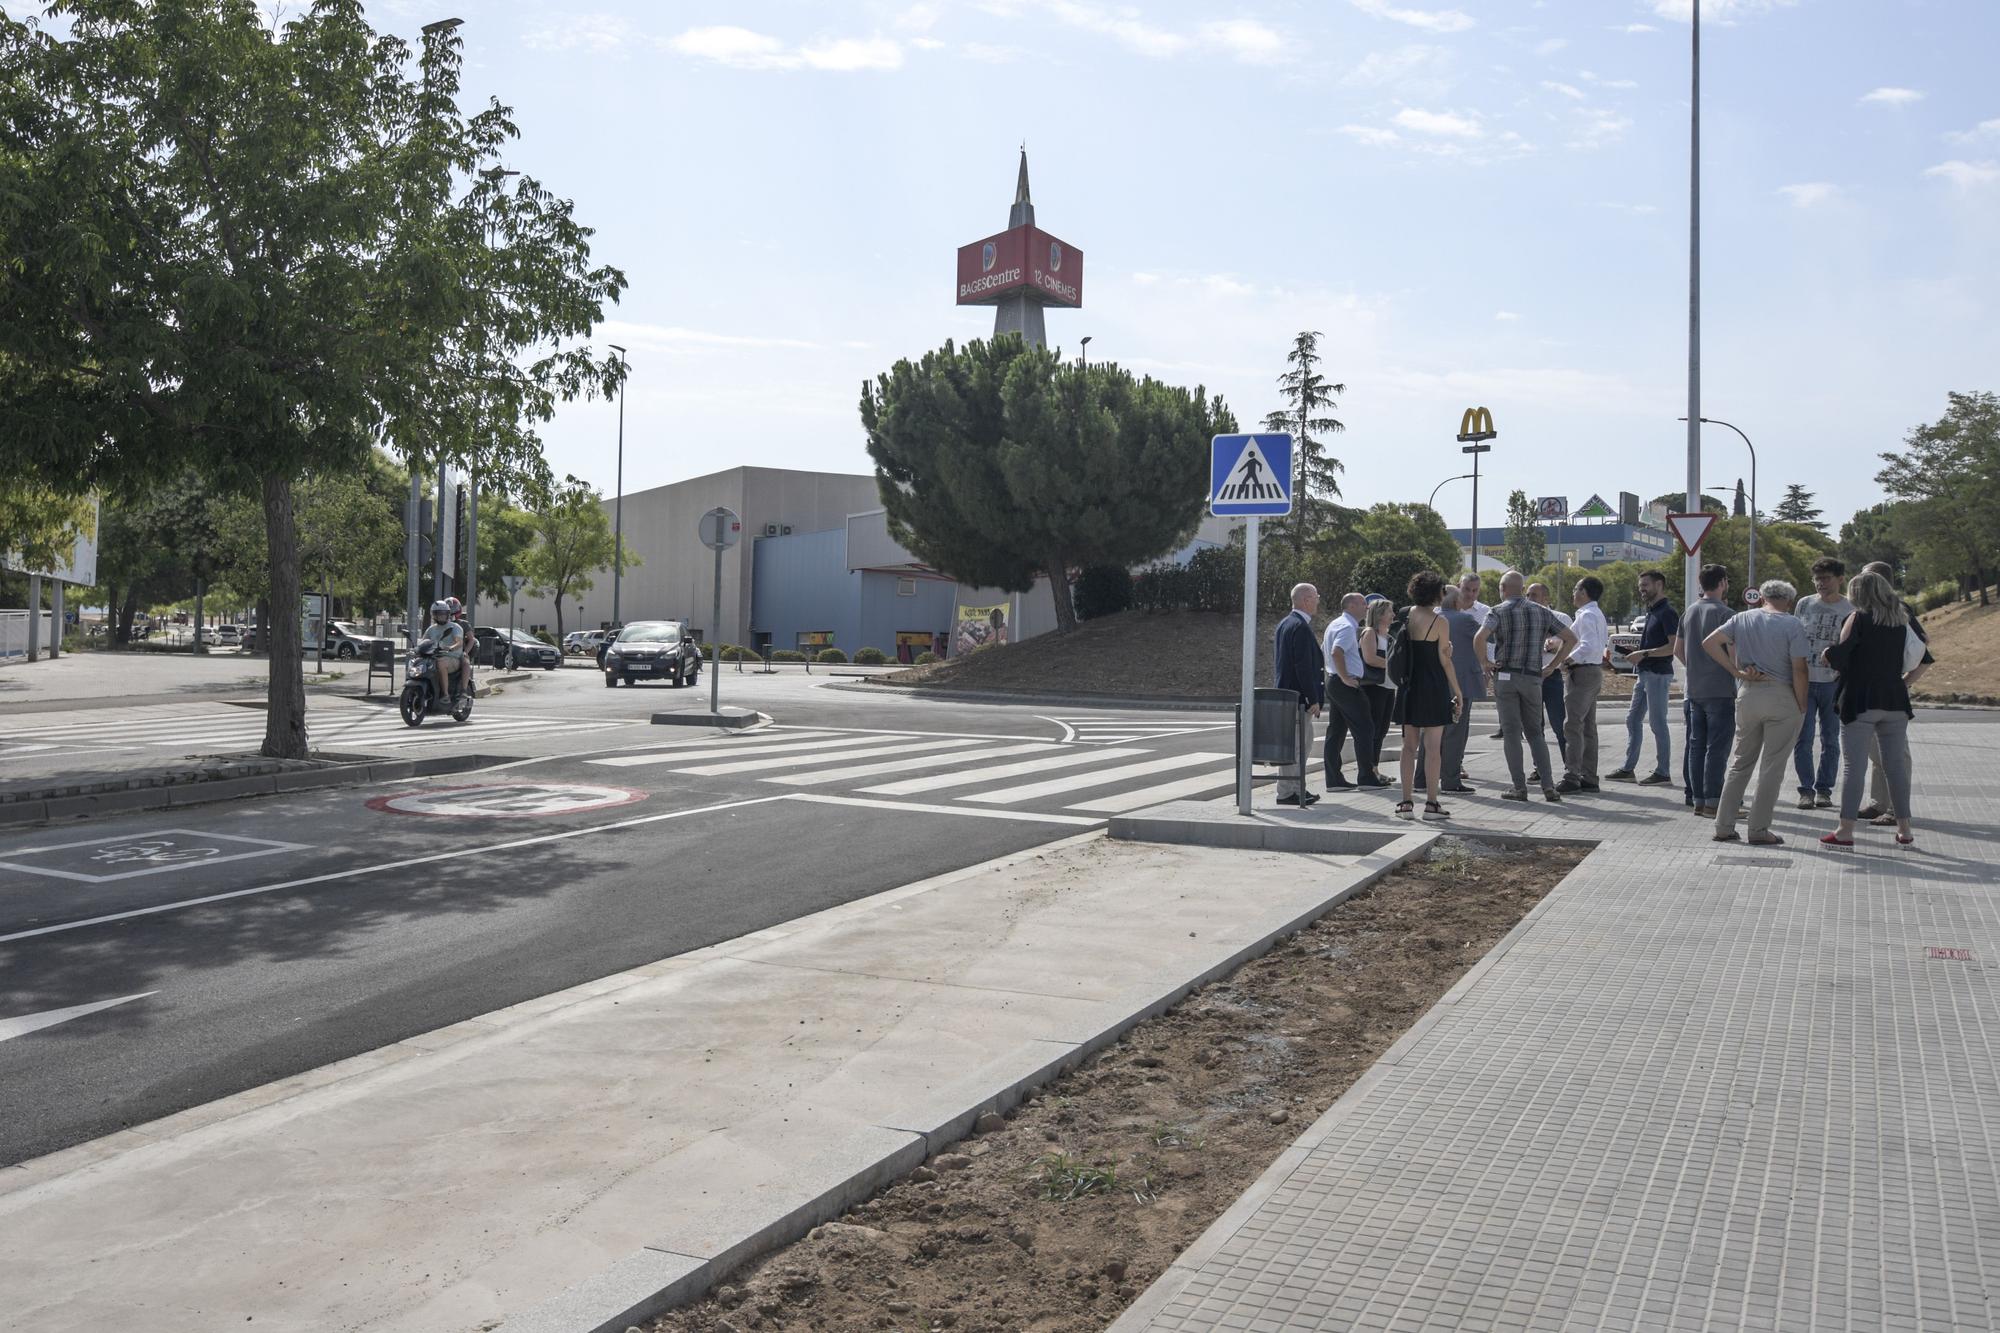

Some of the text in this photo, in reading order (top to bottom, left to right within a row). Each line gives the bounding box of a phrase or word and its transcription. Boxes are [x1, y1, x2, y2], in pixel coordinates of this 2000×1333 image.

[960, 267, 1020, 297] BAGEScentre
[1034, 270, 1077, 301] 12 CINEMES
[1746, 592, 1759, 600] 30
